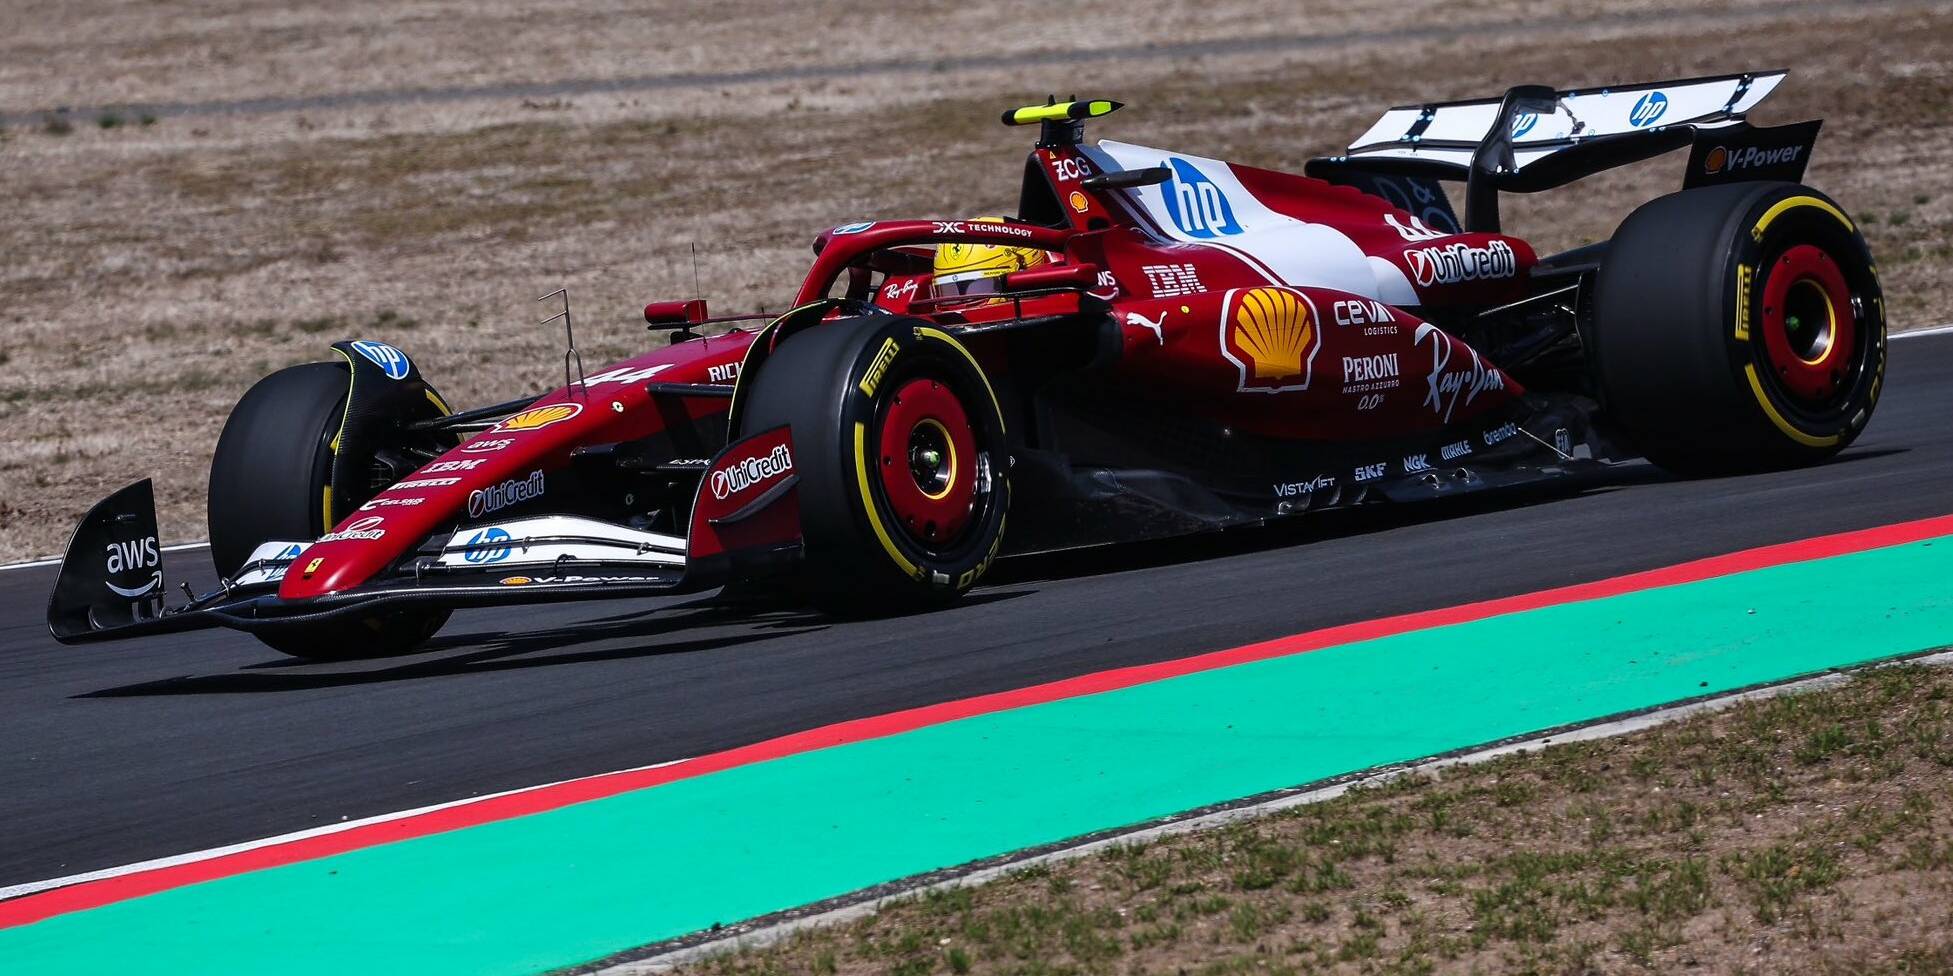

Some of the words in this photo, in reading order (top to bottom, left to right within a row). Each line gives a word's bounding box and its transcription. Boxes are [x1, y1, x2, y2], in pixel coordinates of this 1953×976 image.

[1631, 91, 1668, 127] hp
[1727, 145, 1803, 171] V-Power
[1160, 157, 1245, 239] hp
[933, 221, 965, 234] DXC
[967, 223, 1033, 238] TECHNOLOGY
[1425, 241, 1516, 283] UniCredit
[1143, 264, 1208, 298] IBM
[1364, 326, 1398, 336] LOGISTICS
[351, 340, 410, 379] hp
[858, 336, 900, 398] PIRELLI
[1342, 353, 1399, 383] PERONI
[1342, 385, 1369, 394] NASTRO
[1370, 379, 1400, 390] AZZURRO
[1483, 422, 1517, 446] brembo
[727, 443, 793, 483] UniCredit
[1403, 454, 1430, 472] NGK
[1441, 439, 1472, 460] MAHLE
[420, 459, 488, 474] IBM
[1354, 462, 1387, 482] SKF
[483, 468, 545, 514] UniCredit
[105, 536, 159, 574] aws
[464, 527, 512, 564] hp
[533, 575, 660, 584] V-Power
